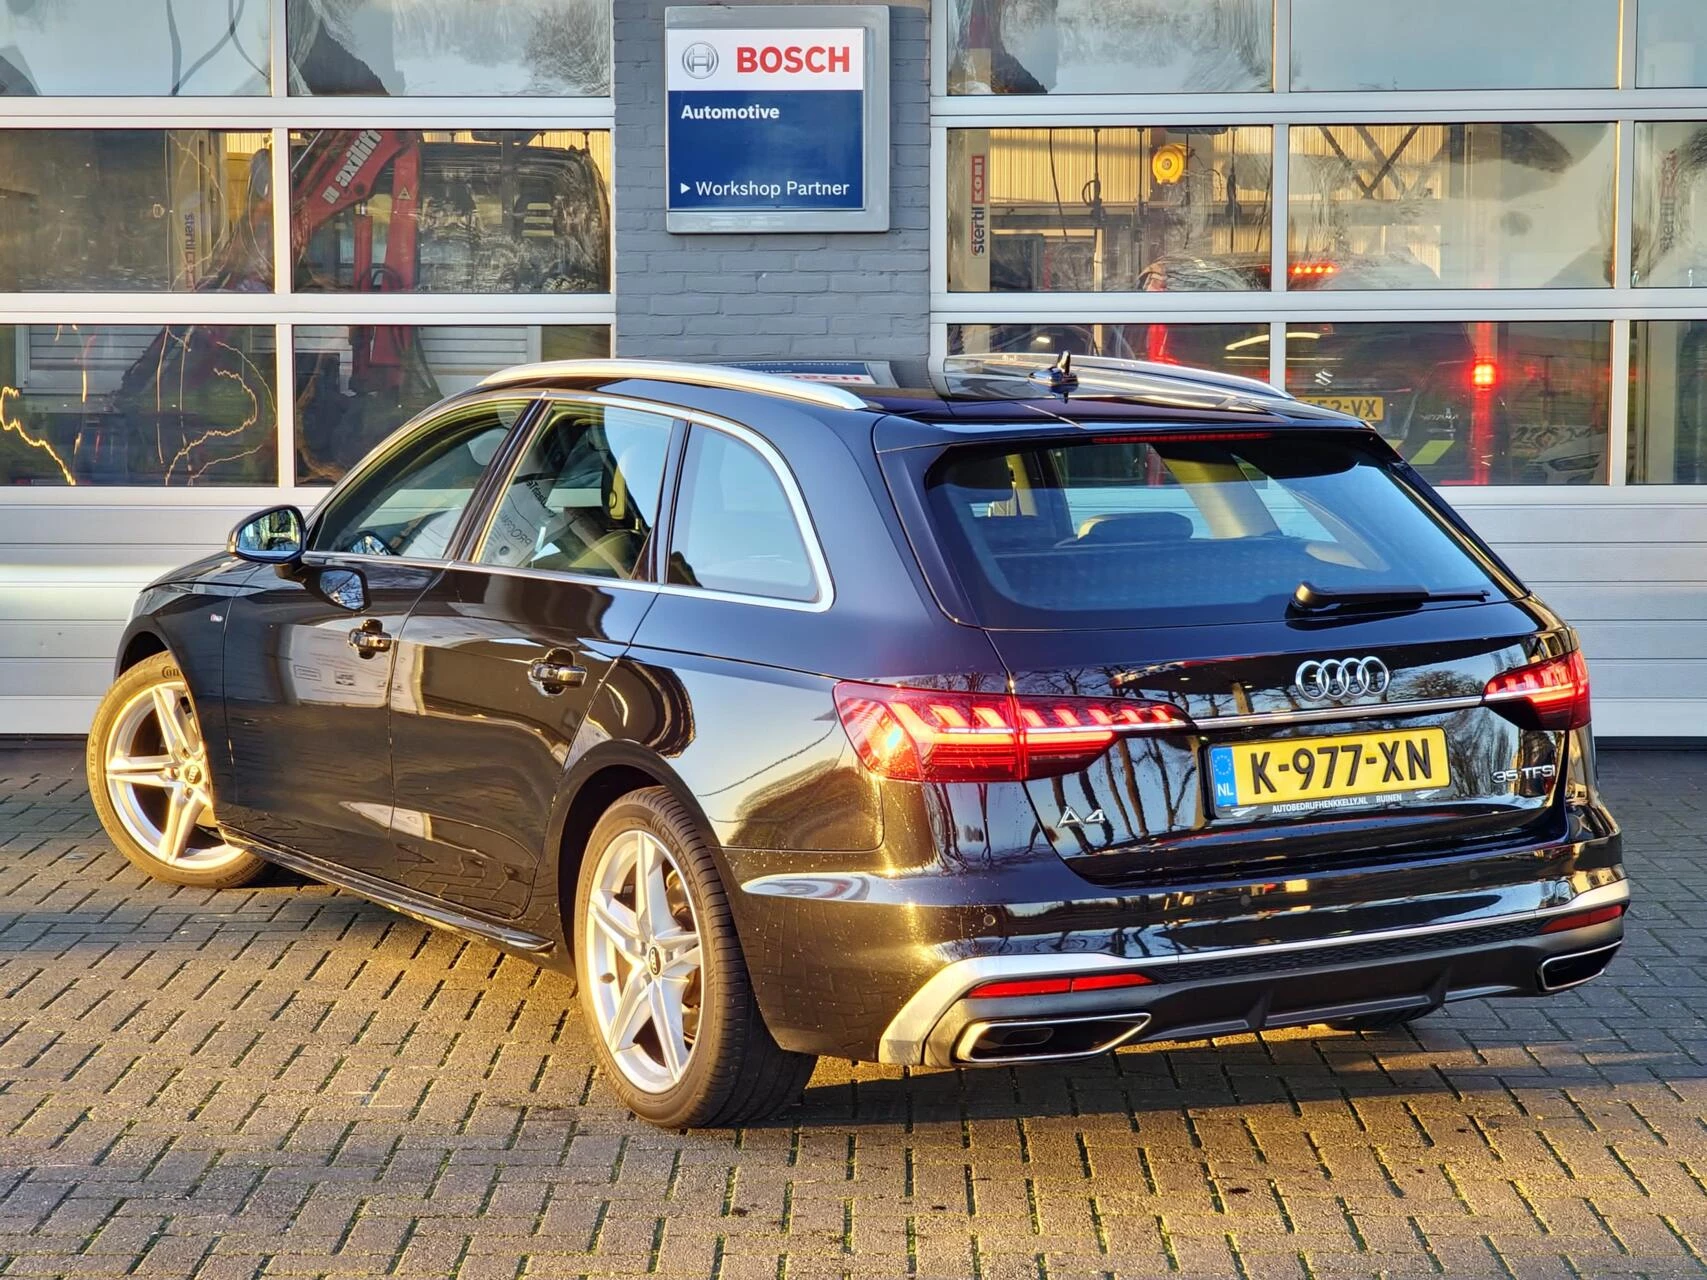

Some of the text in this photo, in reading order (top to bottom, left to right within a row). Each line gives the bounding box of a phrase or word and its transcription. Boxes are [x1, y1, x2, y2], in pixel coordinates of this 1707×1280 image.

[737, 46, 850, 74] BOSCH
[681, 104, 780, 120] Automotive
[696, 181, 850, 199] Workshop Partner
[184, 212, 197, 250] stertil
[971, 206, 985, 255] stertil
[1250, 738, 1432, 795] K-977-XN
[1492, 764, 1556, 783] 35 TFSI
[1217, 782, 1235, 797] NL
[1375, 793, 1402, 804] RUINEN
[1056, 805, 1106, 828] A4
